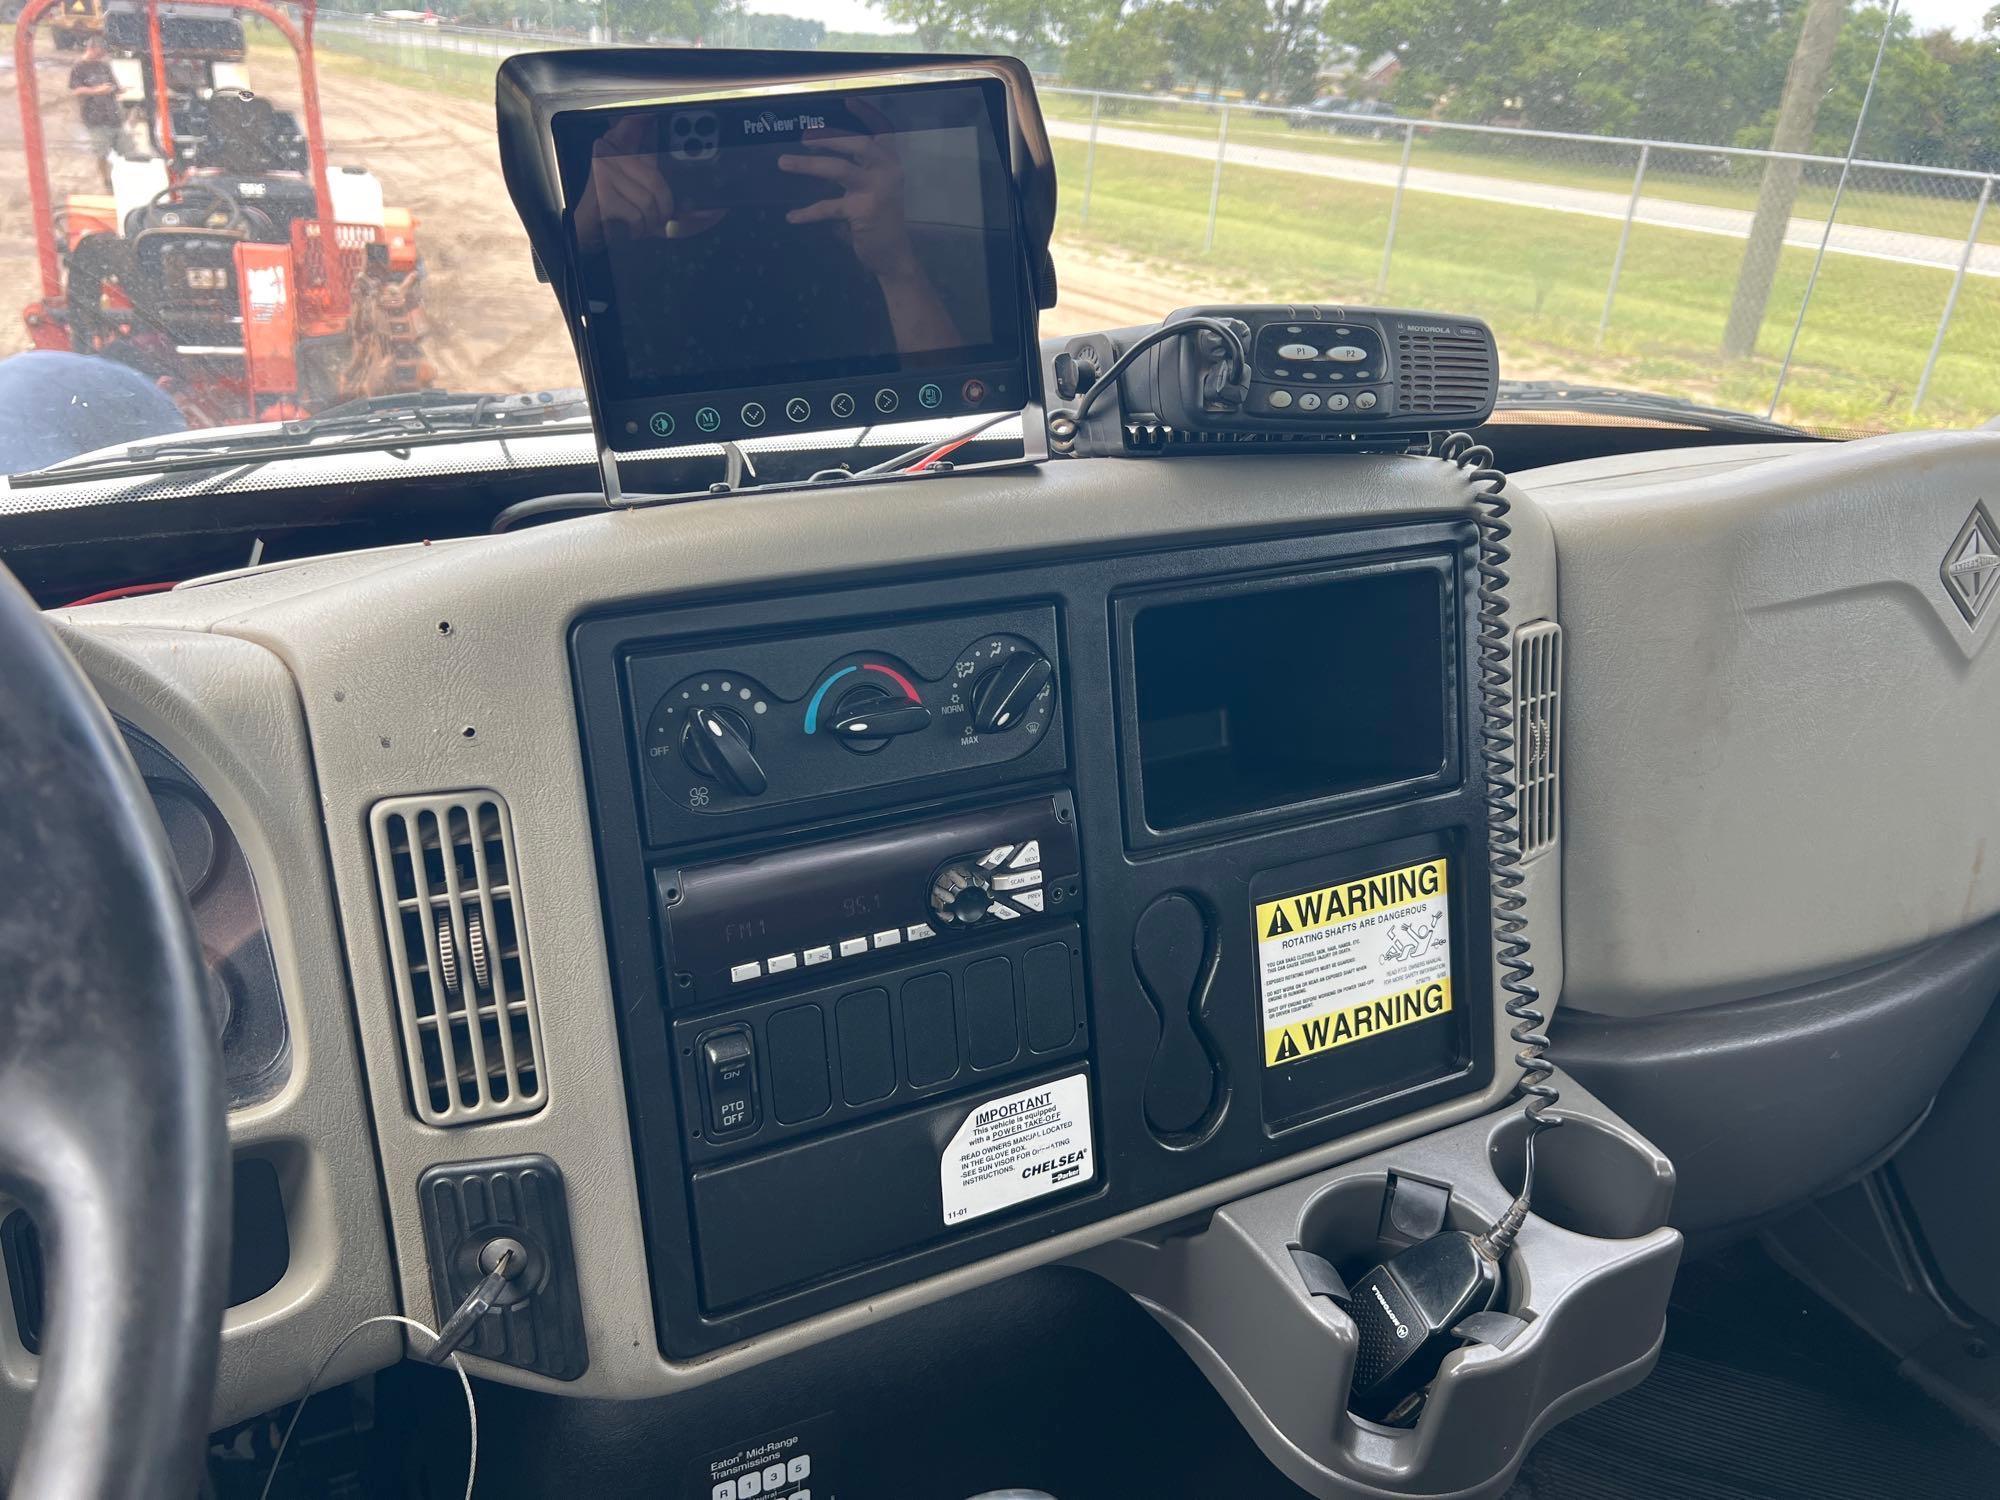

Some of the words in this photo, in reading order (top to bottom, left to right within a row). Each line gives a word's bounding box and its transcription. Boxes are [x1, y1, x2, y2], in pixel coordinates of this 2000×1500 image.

[800, 115, 825, 130] Plus
[1407, 325, 1450, 334] MOTOROLA
[1296, 347, 1305, 355] P1
[1346, 350, 1355, 358] P2
[942, 704, 964, 715] NORM
[960, 736, 979, 746] MAX
[650, 746, 670, 757] OFF
[1024, 856, 1038, 864] NEXT
[1010, 878, 1025, 886] SCAN
[1027, 892, 1041, 900] PREV
[1294, 864, 1438, 928] WARNING
[1282, 932, 1323, 949] ROTATING
[1325, 922, 1357, 938] SHAFTS
[1359, 918, 1376, 928] ARE
[1378, 904, 1427, 924] DANGEROUS
[920, 930, 930, 938] ESC
[1302, 984, 1443, 1050] WARNING
[724, 1070, 740, 1080] ON
[722, 1100, 744, 1114] PTO
[976, 1092, 1052, 1126] IMPORTANT
[724, 1112, 744, 1126] OFF
[973, 1127, 988, 1136] This
[990, 1118, 1015, 1130] vehicle
[1024, 1105, 1056, 1120] equipped
[969, 1136, 985, 1146] with
[992, 1124, 1022, 1138] POWER
[1024, 1112, 1061, 1128] TAKE-OFF
[982, 1140, 1012, 1154] OWNERS
[1042, 1121, 1072, 1136] LOCATED
[970, 1158, 984, 1168] THE
[986, 1151, 1009, 1162] GLOVE
[978, 1163, 992, 1174] SUN
[994, 1156, 1016, 1168] VISOR
[1016, 1151, 1030, 1161] FOR
[962, 1164, 1016, 1186] INSTRUCTIONS.
[948, 1208, 968, 1219] 11-01
[1372, 1284, 1400, 1326] MOTOROLA
[710, 1456, 740, 1472] Eaton
[746, 1436, 798, 1459] Mid-Range
[710, 1452, 781, 1480] Transmissions
[795, 1464, 802, 1473] 5
[770, 1473, 778, 1482] 3
[746, 1481, 752, 1489] 1
[720, 1490, 728, 1499] R
